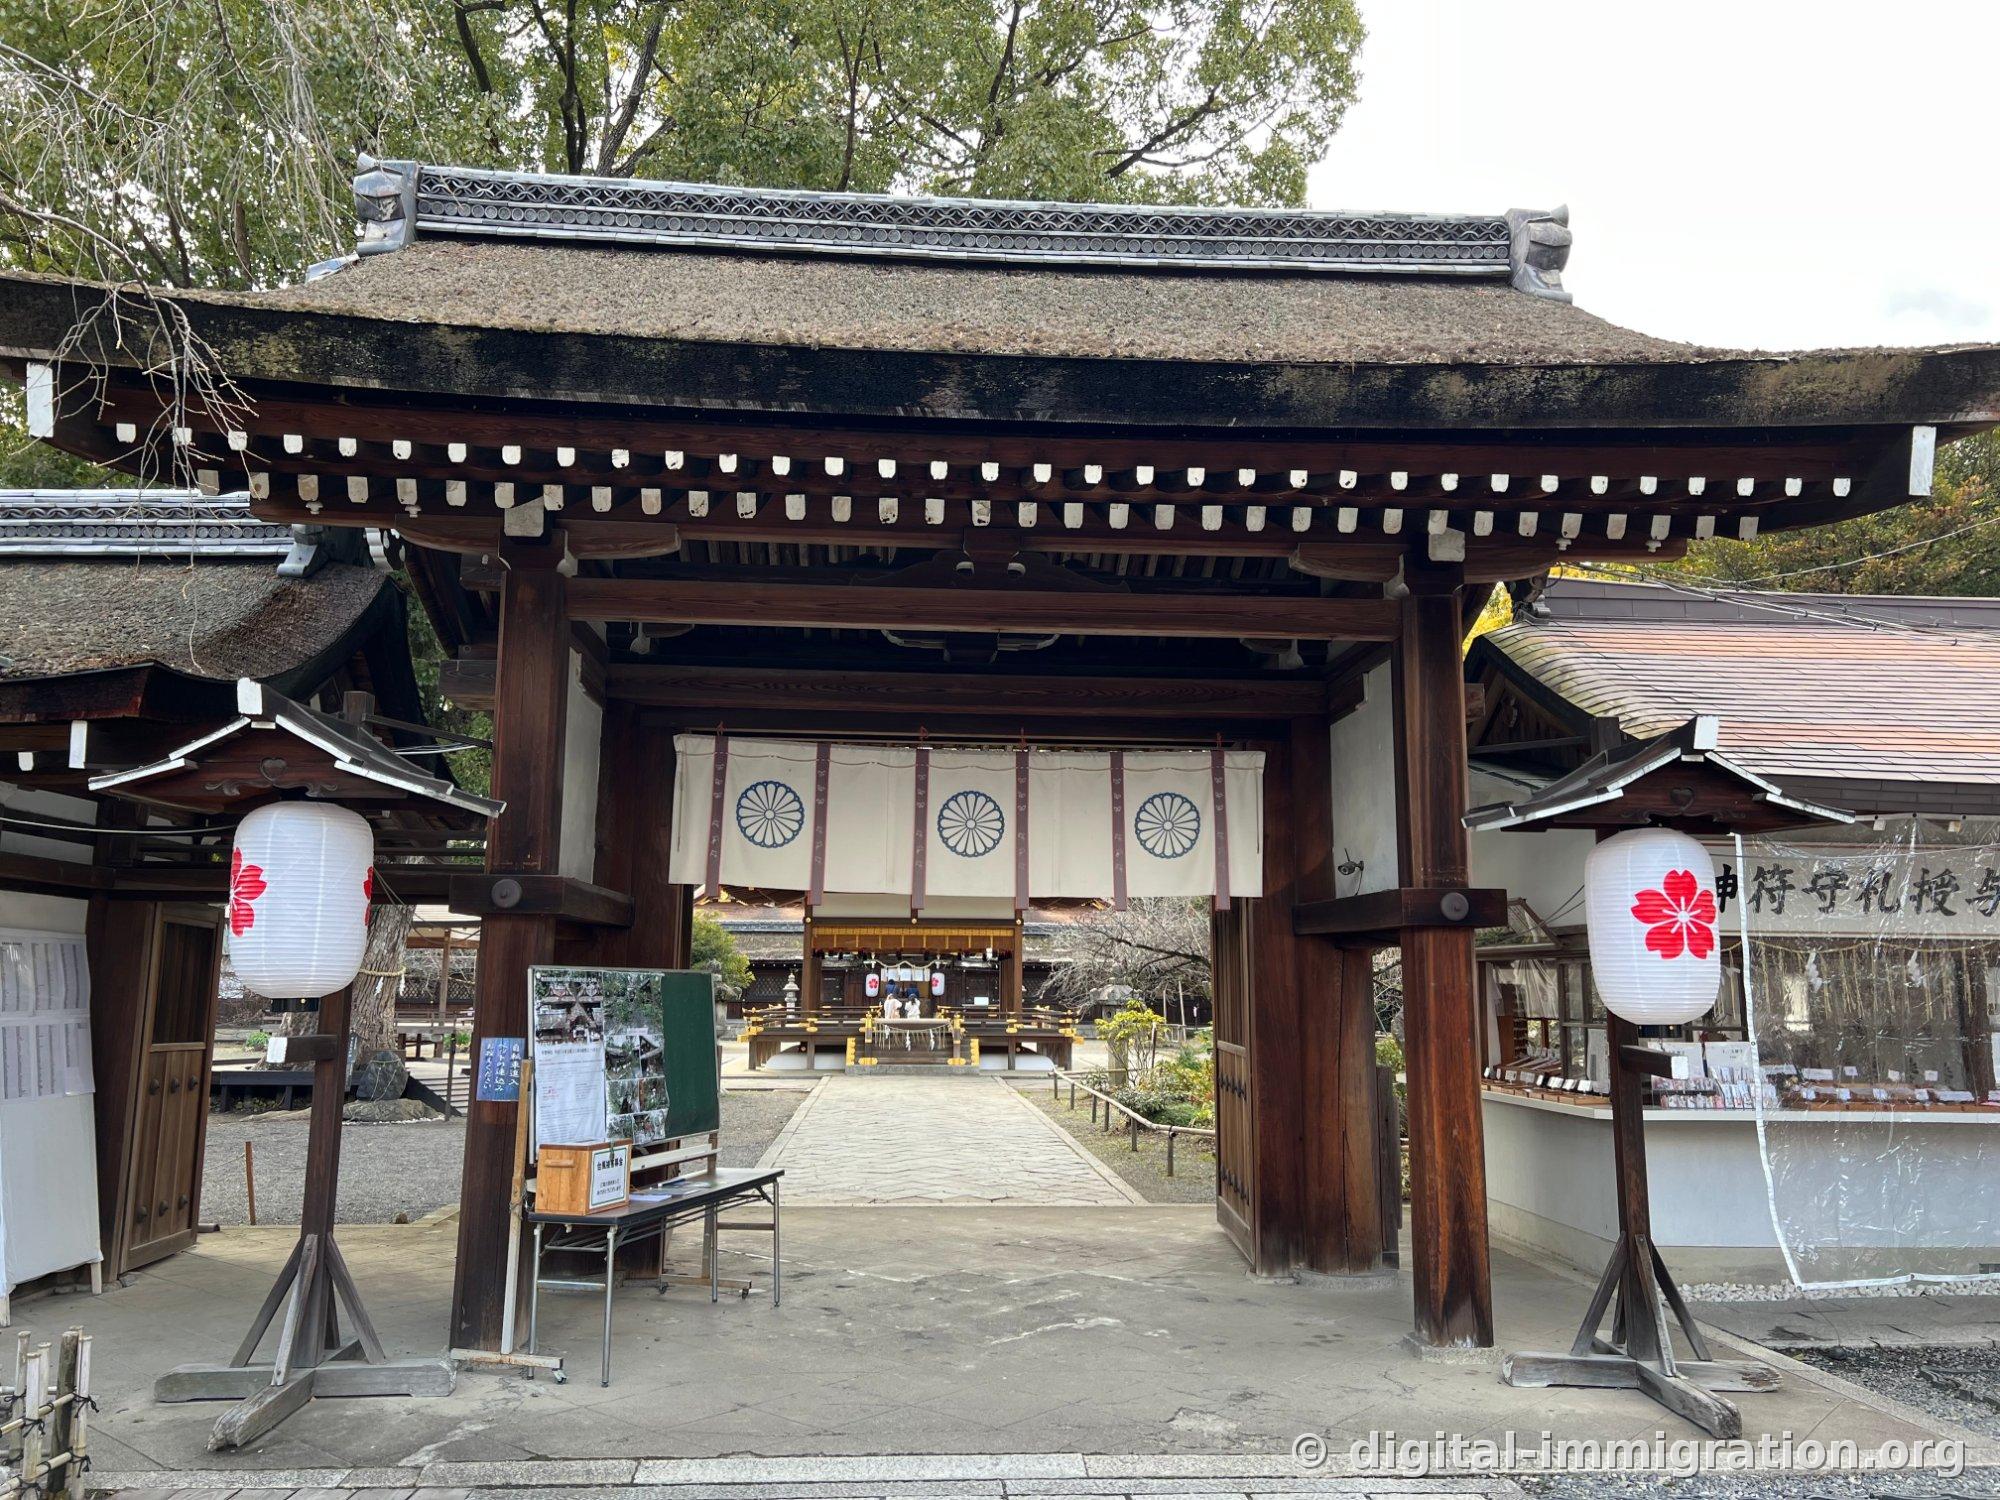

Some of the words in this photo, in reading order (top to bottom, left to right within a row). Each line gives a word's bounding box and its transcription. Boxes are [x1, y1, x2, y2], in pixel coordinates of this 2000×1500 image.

[509, 1044, 522, 1086] 自転車進入
